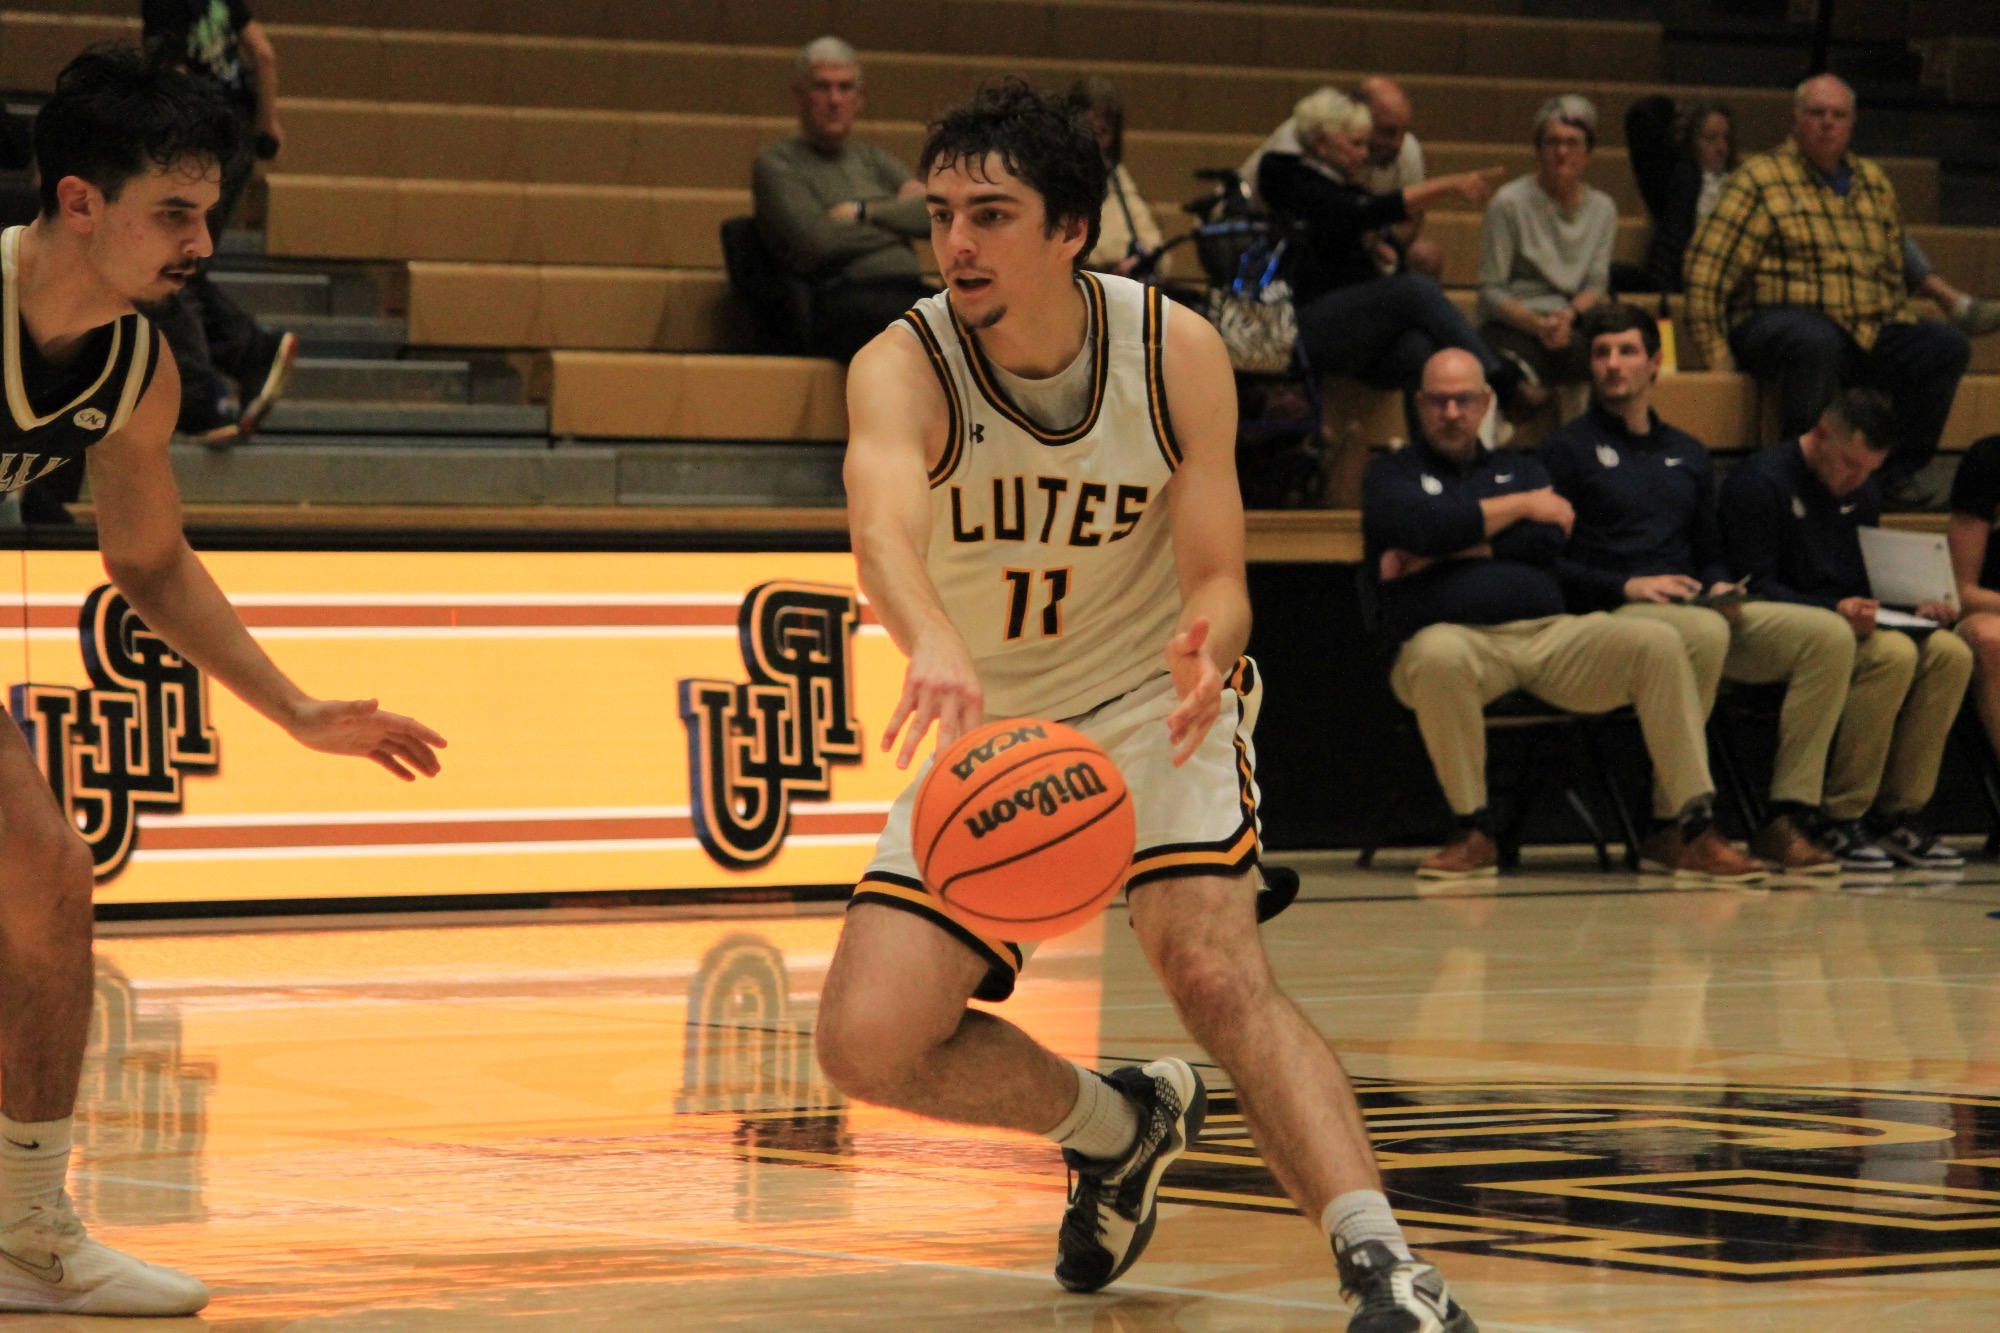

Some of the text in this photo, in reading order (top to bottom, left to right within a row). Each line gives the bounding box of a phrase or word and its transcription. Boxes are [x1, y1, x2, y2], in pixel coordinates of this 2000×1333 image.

[950, 474, 1150, 548] LUTES
[1001, 565, 1072, 641] 11
[950, 725, 1049, 782] NCAA
[964, 762, 1108, 839] Wilson
